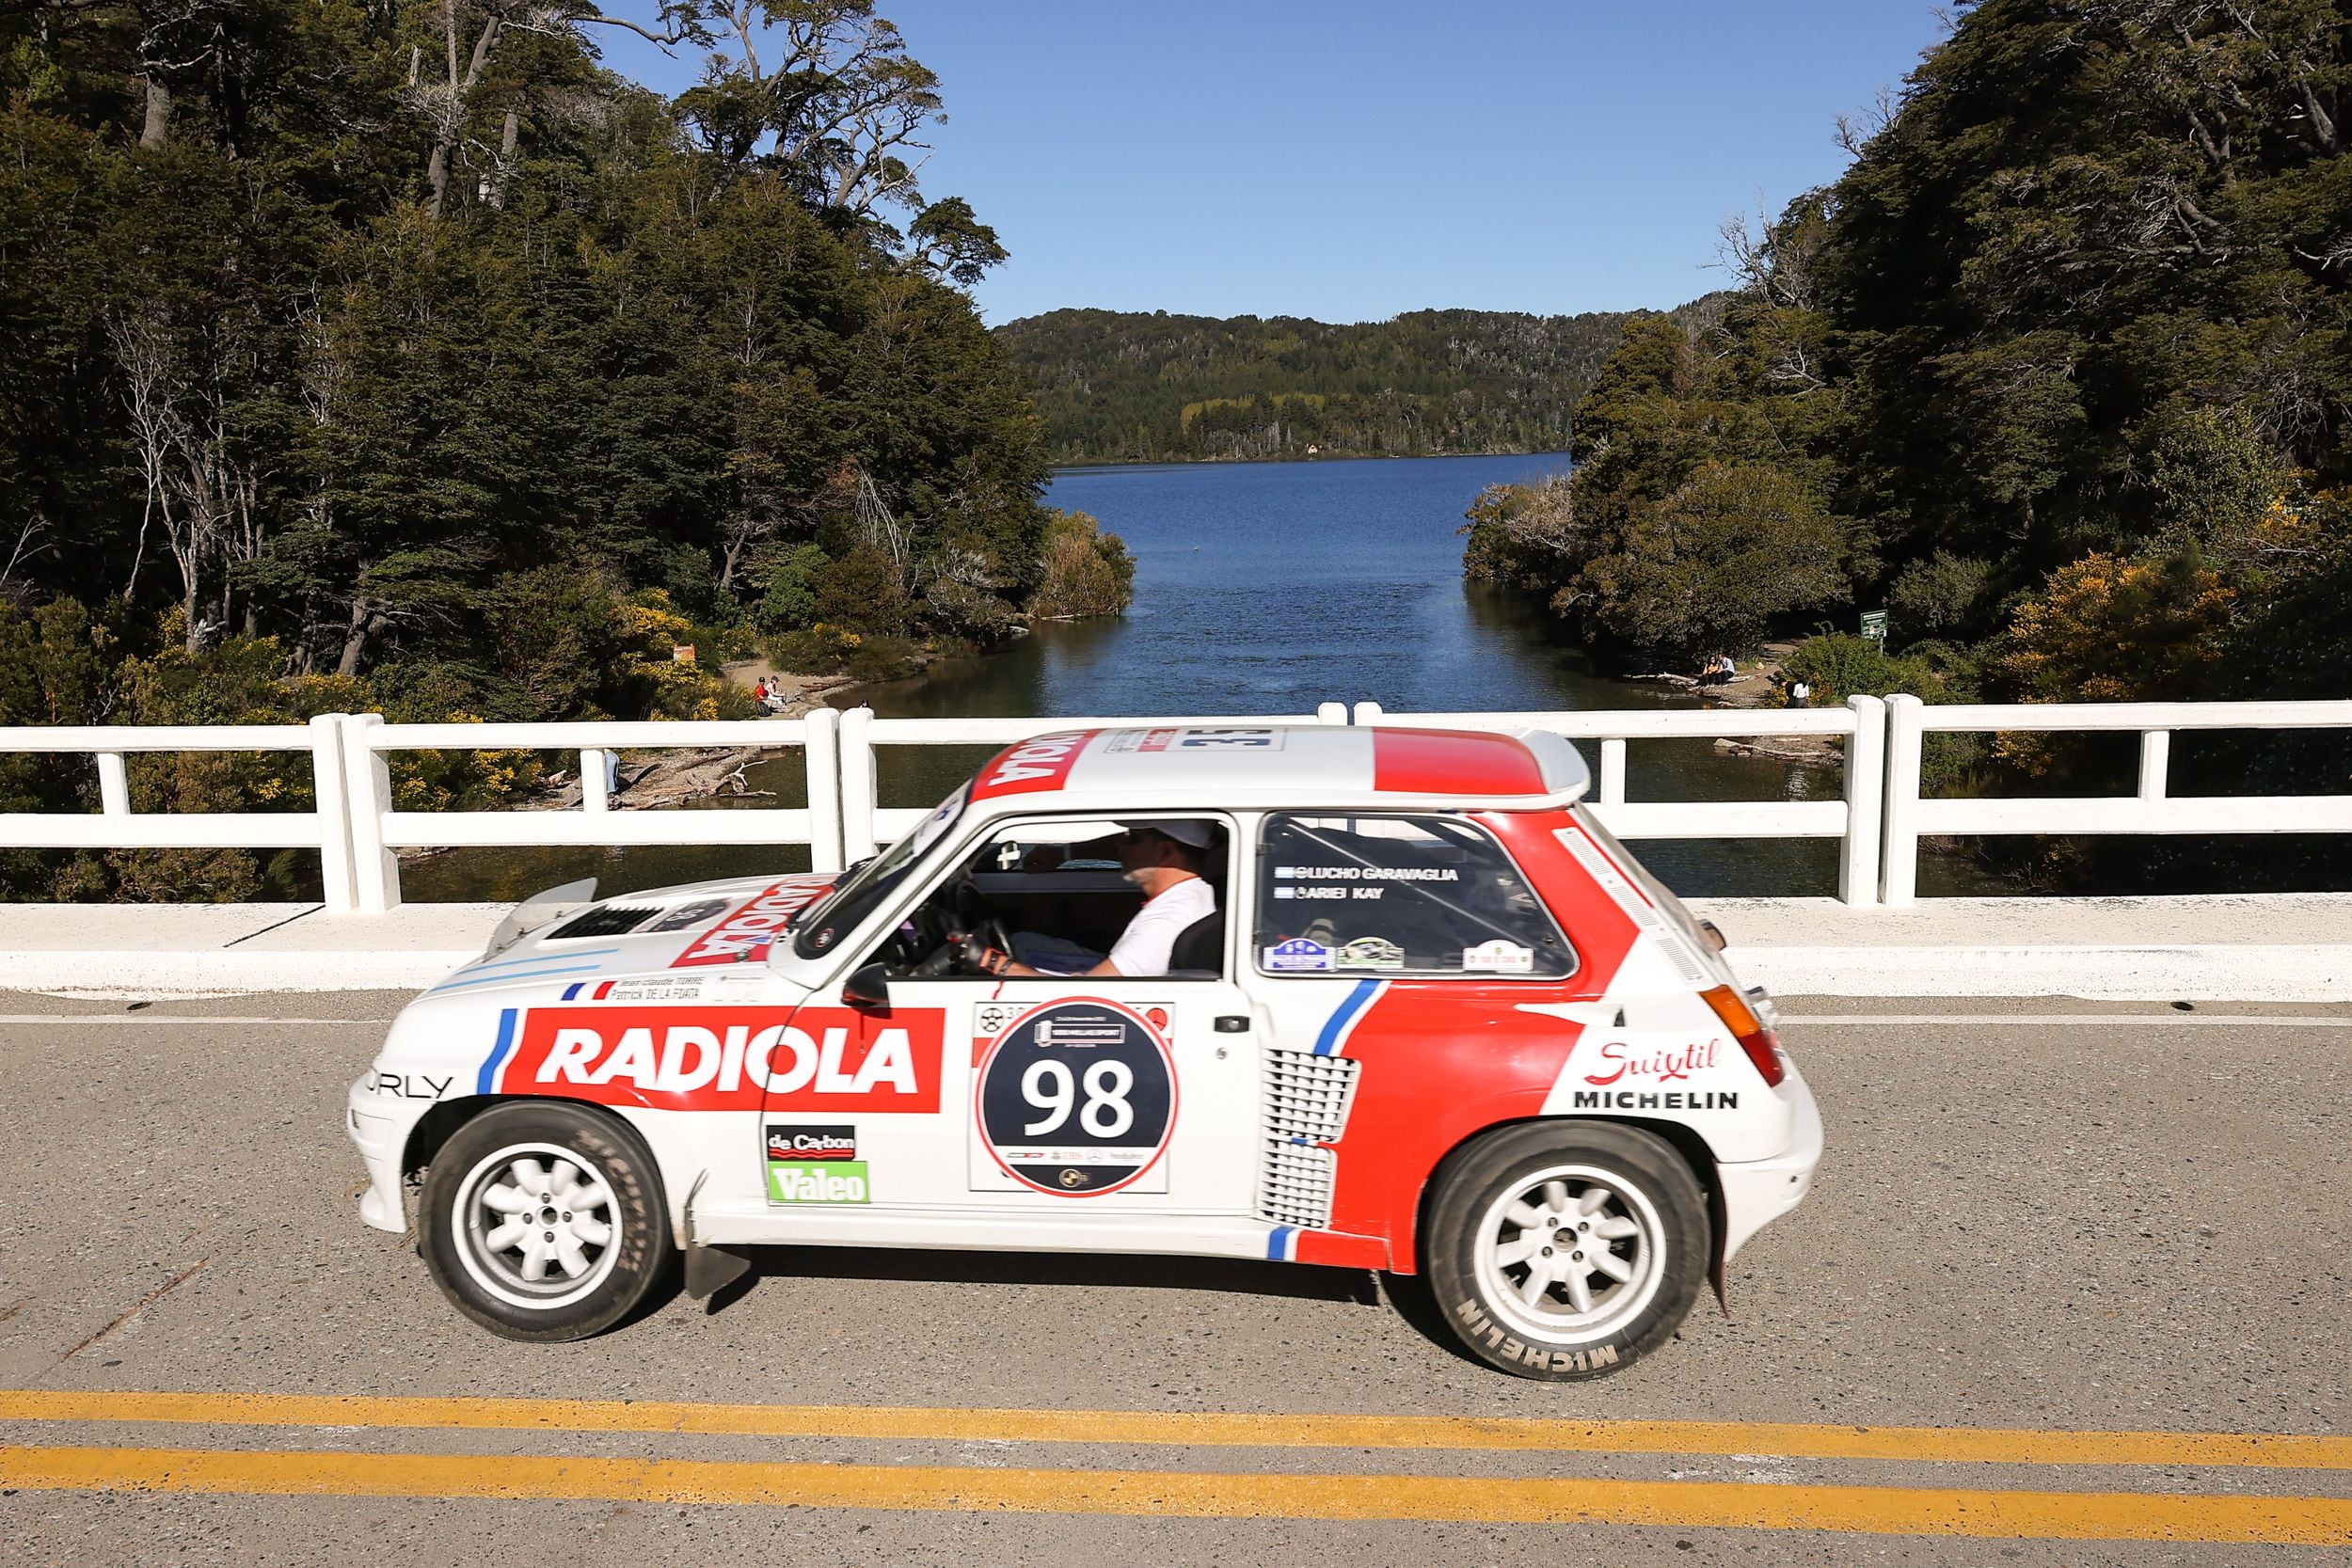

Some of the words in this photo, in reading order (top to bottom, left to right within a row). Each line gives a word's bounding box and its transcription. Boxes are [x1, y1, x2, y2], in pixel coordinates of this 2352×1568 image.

[1181, 729, 1272, 747] 35
[987, 730, 1088, 786] DIOLA
[1361, 867, 1458, 881] GARAVAGLIA
[1352, 887, 1385, 899] KAY
[685, 879, 834, 959] RADIOLA
[534, 1024, 919, 1095] RADIOLA
[364, 1072, 455, 1100] RLY
[1021, 1058, 1135, 1139] 98
[1573, 1091, 1739, 1110] MICHELIN
[768, 1133, 792, 1150] de
[793, 1133, 855, 1150] Carbon
[771, 1167, 866, 1201] Valeo
[1455, 1297, 1620, 1373] MICHELIN
